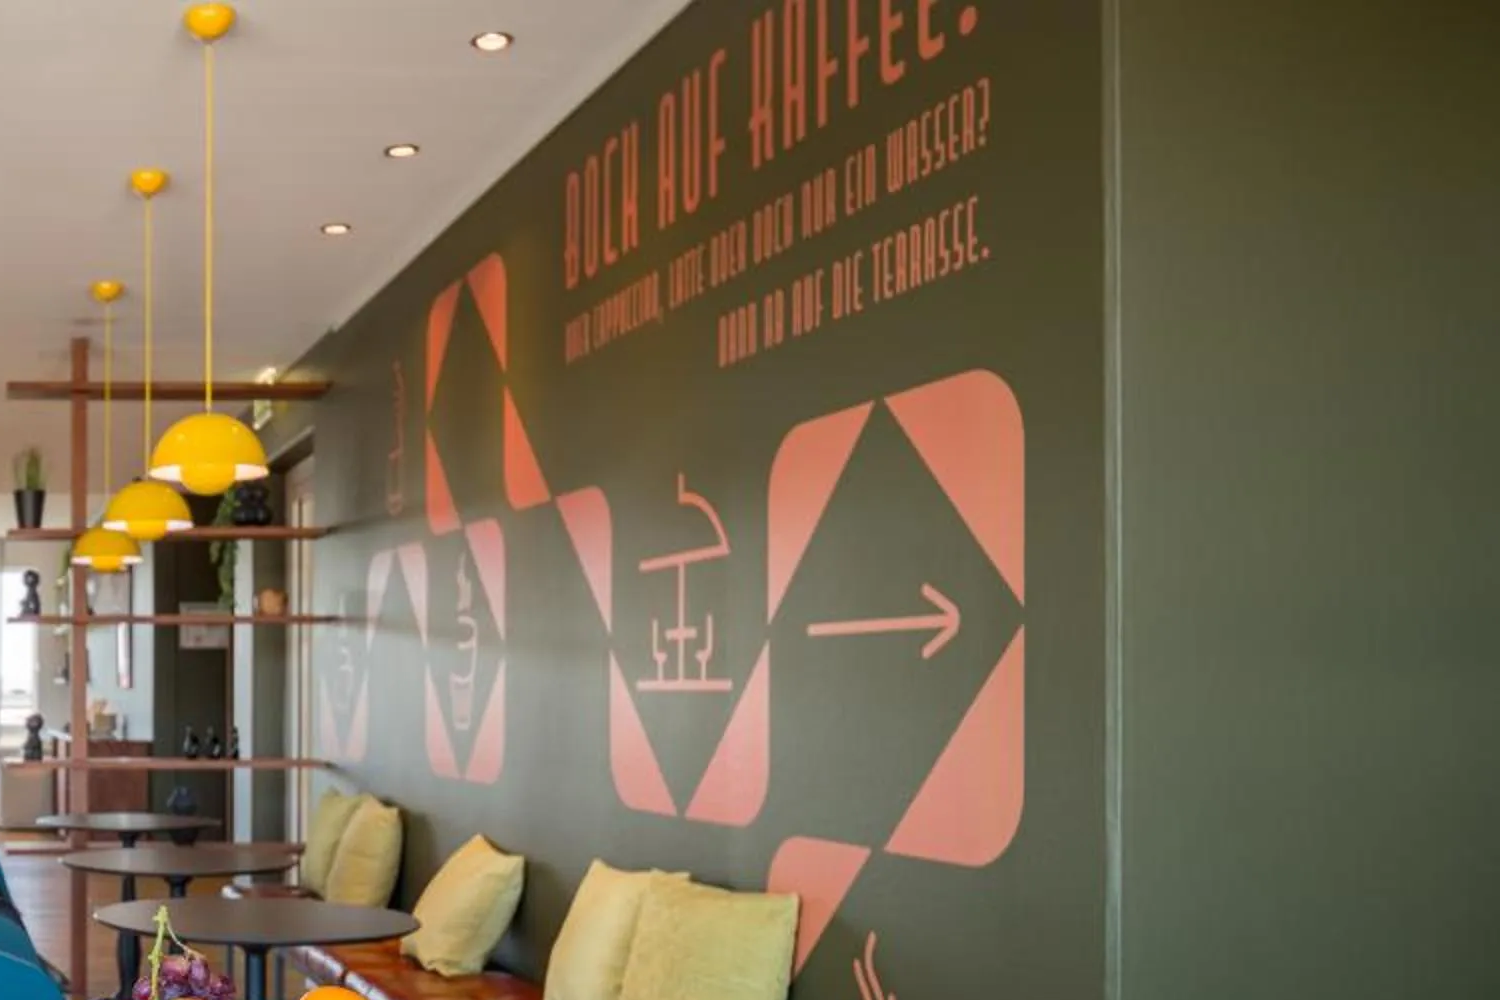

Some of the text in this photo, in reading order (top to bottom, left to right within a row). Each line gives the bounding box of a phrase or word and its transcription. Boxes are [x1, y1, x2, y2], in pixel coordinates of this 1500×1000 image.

[658, 48, 725, 230] AUF
[845, 143, 876, 216] EIN
[886, 77, 989, 193] WASSER?
[832, 249, 863, 319] DIE
[871, 195, 990, 303] TERRASSE.
